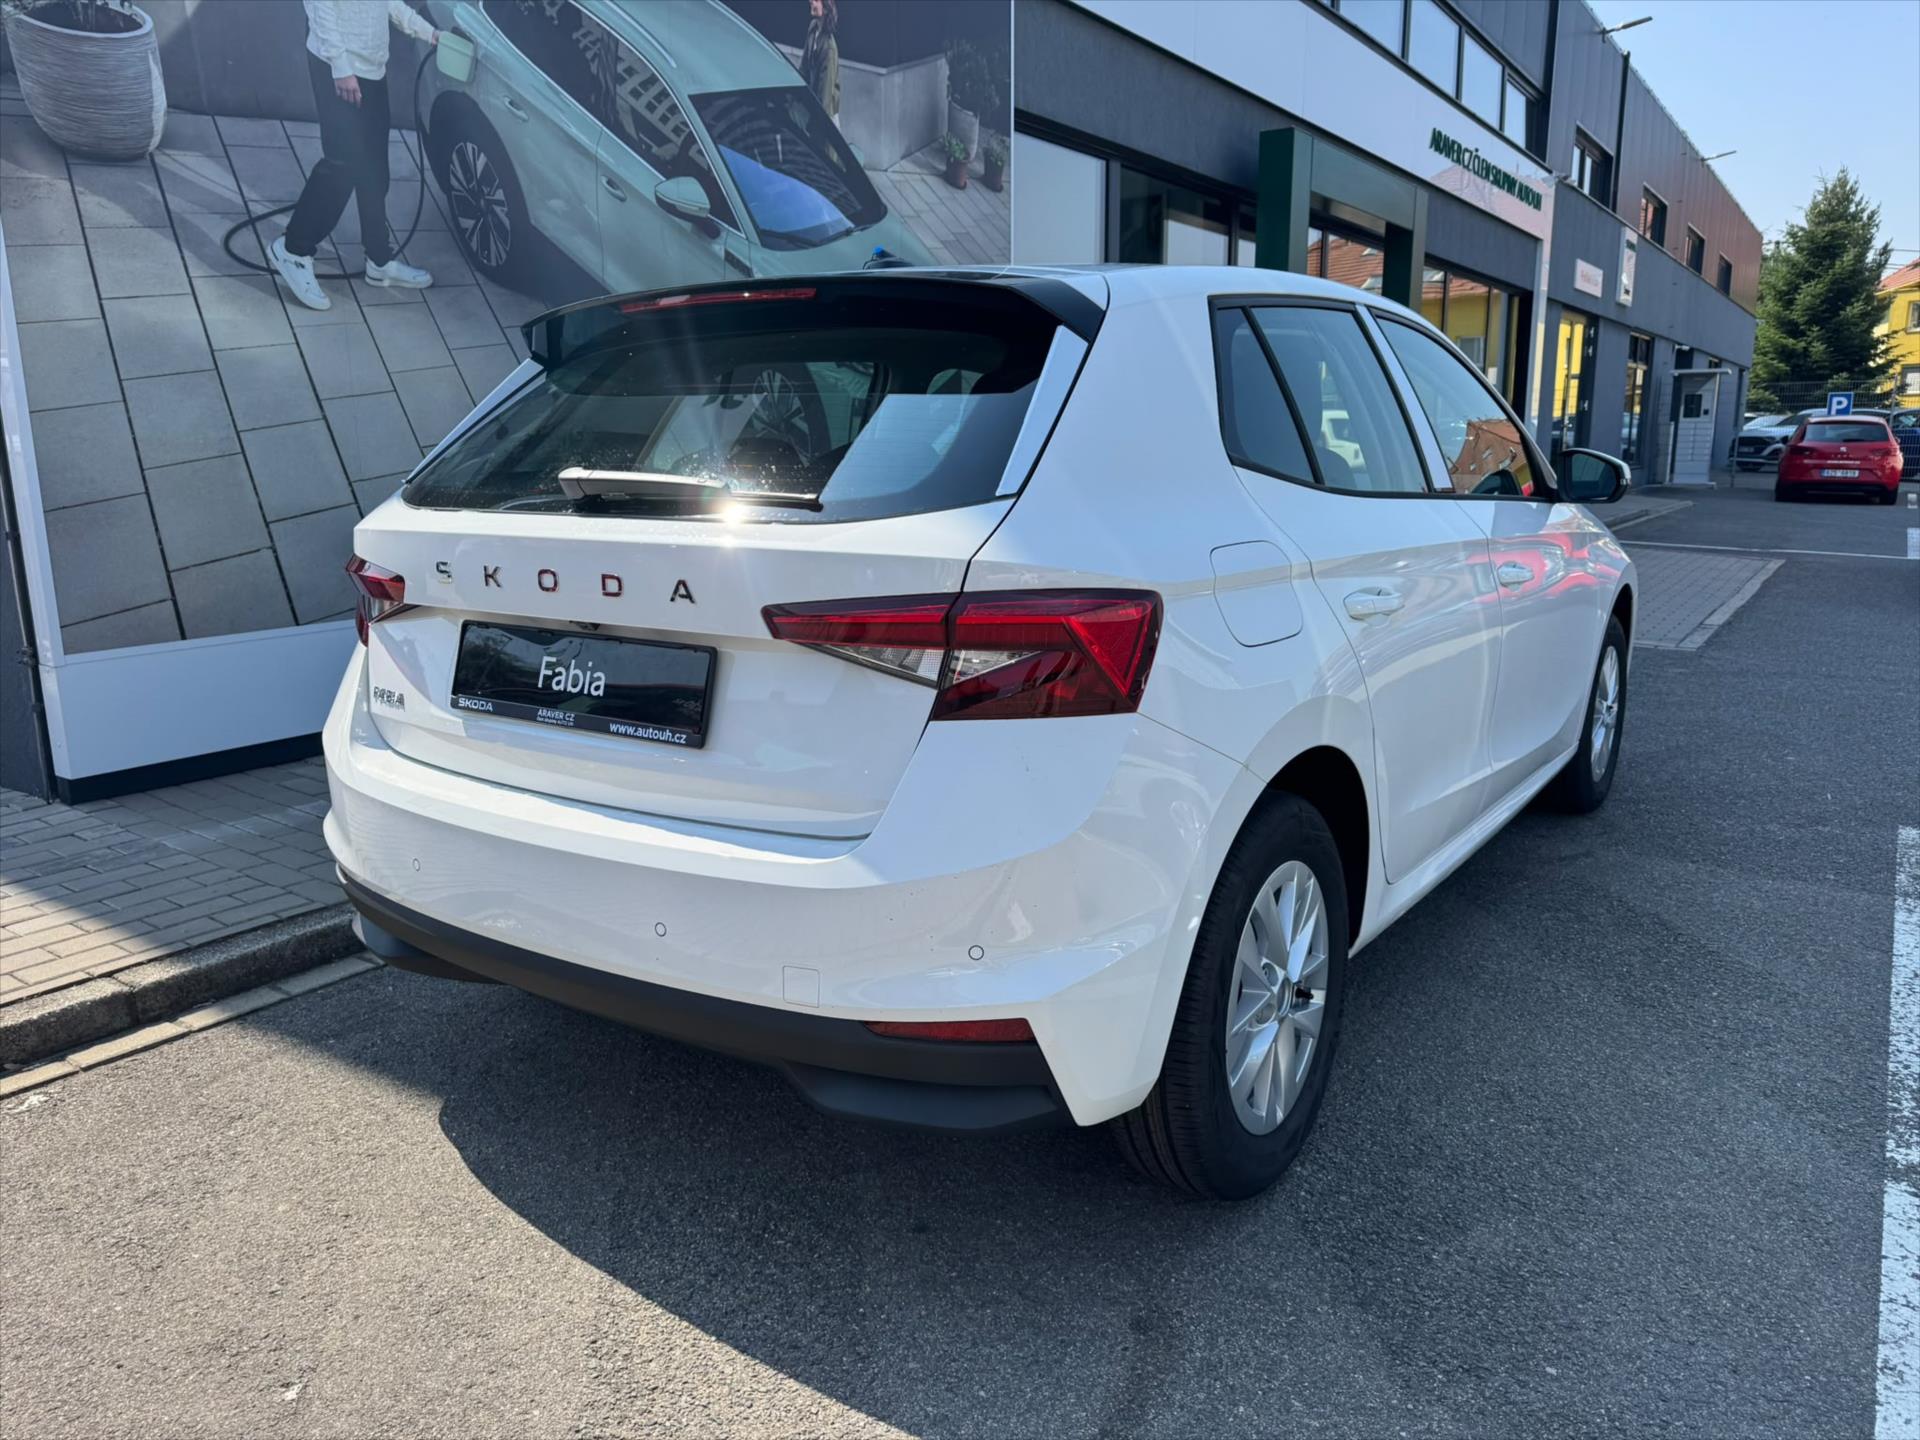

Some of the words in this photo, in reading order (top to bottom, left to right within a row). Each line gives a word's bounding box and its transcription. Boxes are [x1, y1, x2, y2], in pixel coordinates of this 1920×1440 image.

[1831, 397, 1848, 415] P
[537, 656, 606, 697] Fabia
[537, 708, 564, 720] ARAVER
[565, 713, 575, 722] CZ
[609, 722, 687, 744] www.autouh.cz
